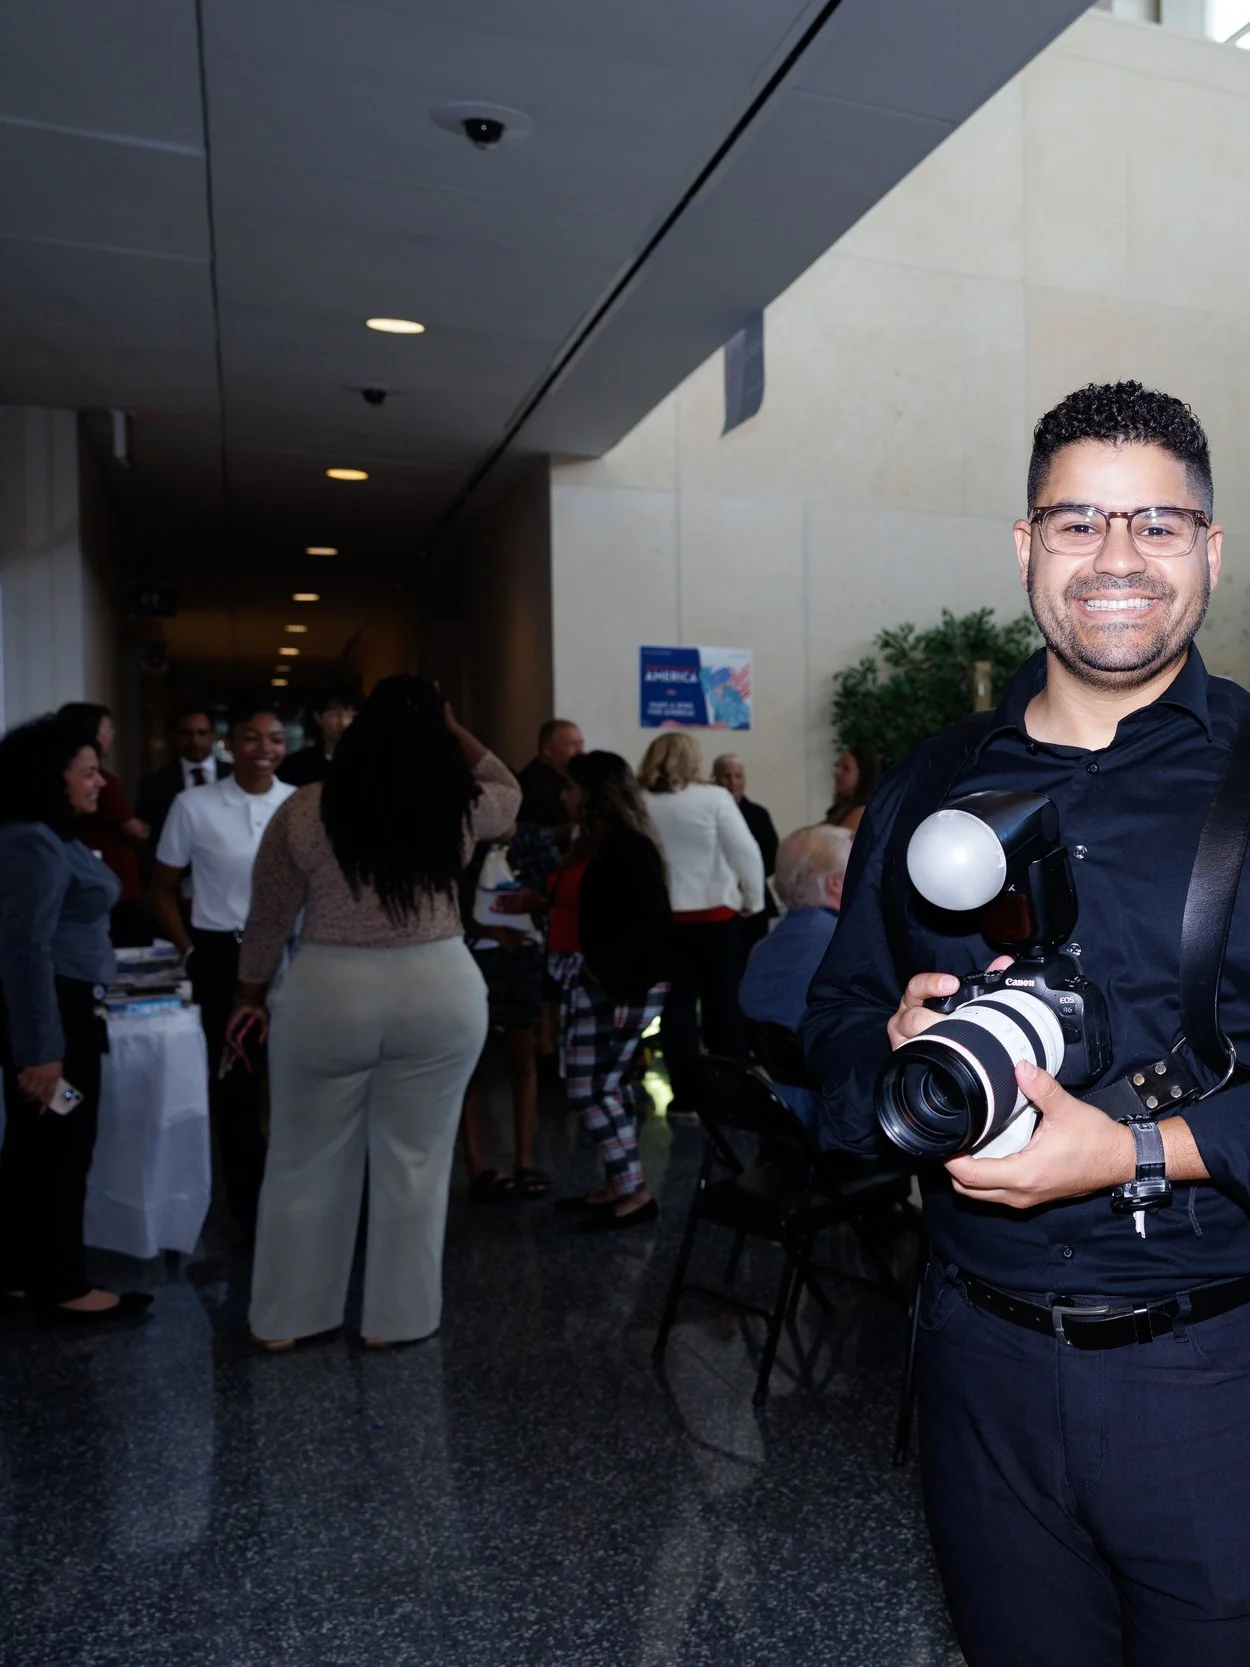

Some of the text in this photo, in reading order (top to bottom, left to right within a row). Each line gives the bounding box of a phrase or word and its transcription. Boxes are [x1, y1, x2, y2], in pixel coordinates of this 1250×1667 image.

[644, 670, 698, 683] AMERICA
[1005, 977, 1035, 987] Canon
[1059, 996, 1075, 1004] EOS
